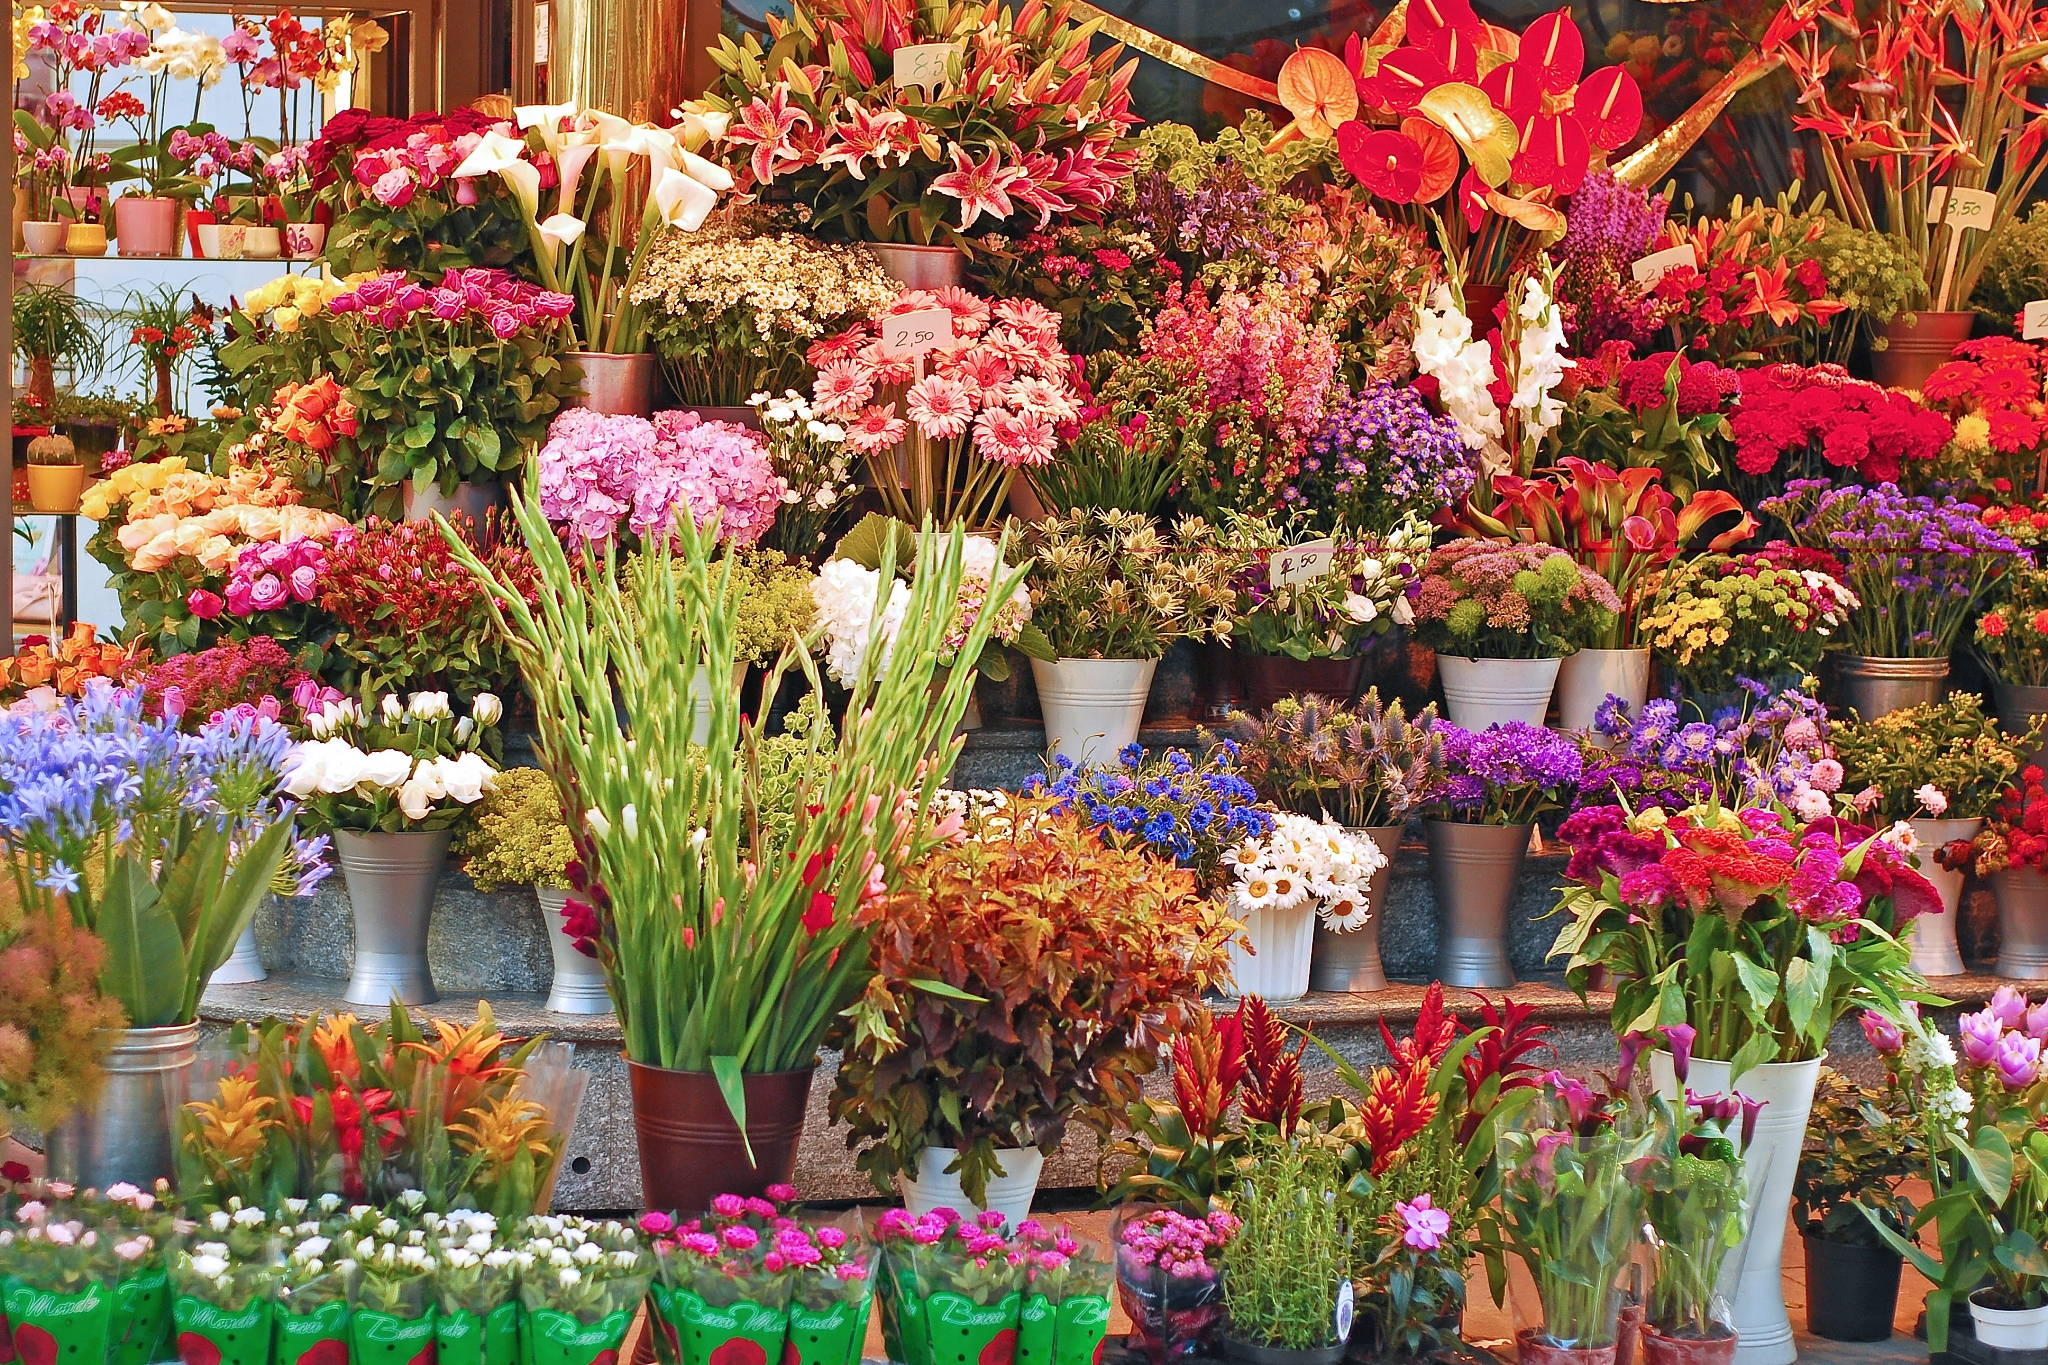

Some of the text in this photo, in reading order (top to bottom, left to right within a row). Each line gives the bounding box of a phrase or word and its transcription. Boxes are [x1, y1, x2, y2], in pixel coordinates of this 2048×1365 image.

[895, 330, 934, 347] 2,50
[14, 1285, 101, 1317] Monde
[178, 1298, 260, 1330] Monde
[675, 1292, 738, 1330] Beau
[933, 1296, 1005, 1326] Beau
